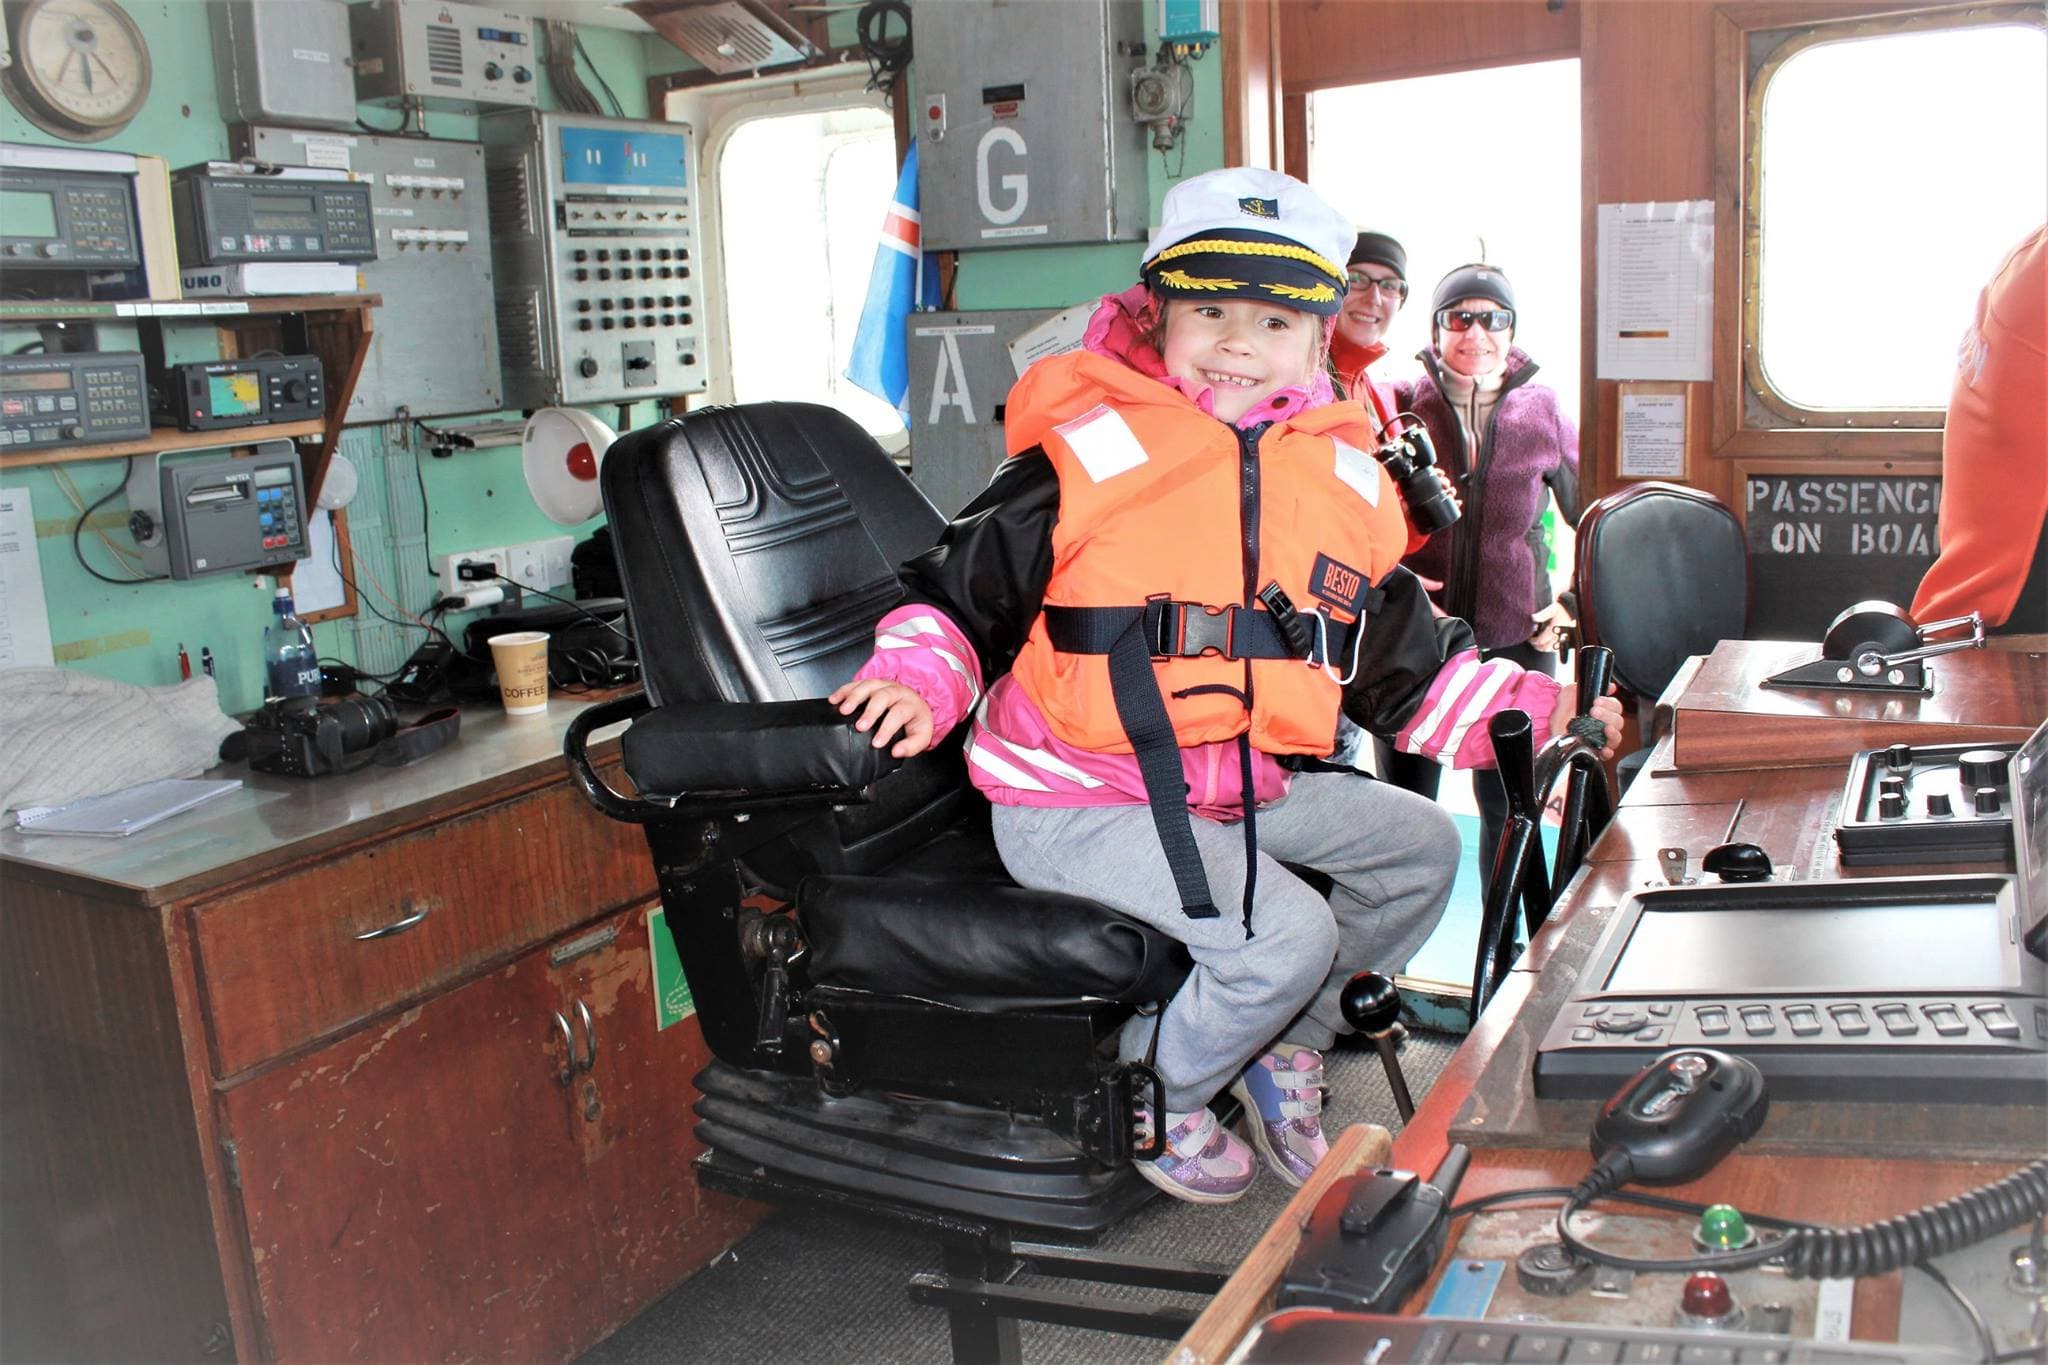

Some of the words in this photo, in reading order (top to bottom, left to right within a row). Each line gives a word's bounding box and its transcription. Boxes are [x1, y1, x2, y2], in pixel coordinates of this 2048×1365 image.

[977, 126, 1029, 225] G
[928, 333, 977, 425] A
[1771, 522, 1821, 554] ON
[1323, 563, 1360, 599] BESTO
[505, 685, 544, 698] COFFEE
